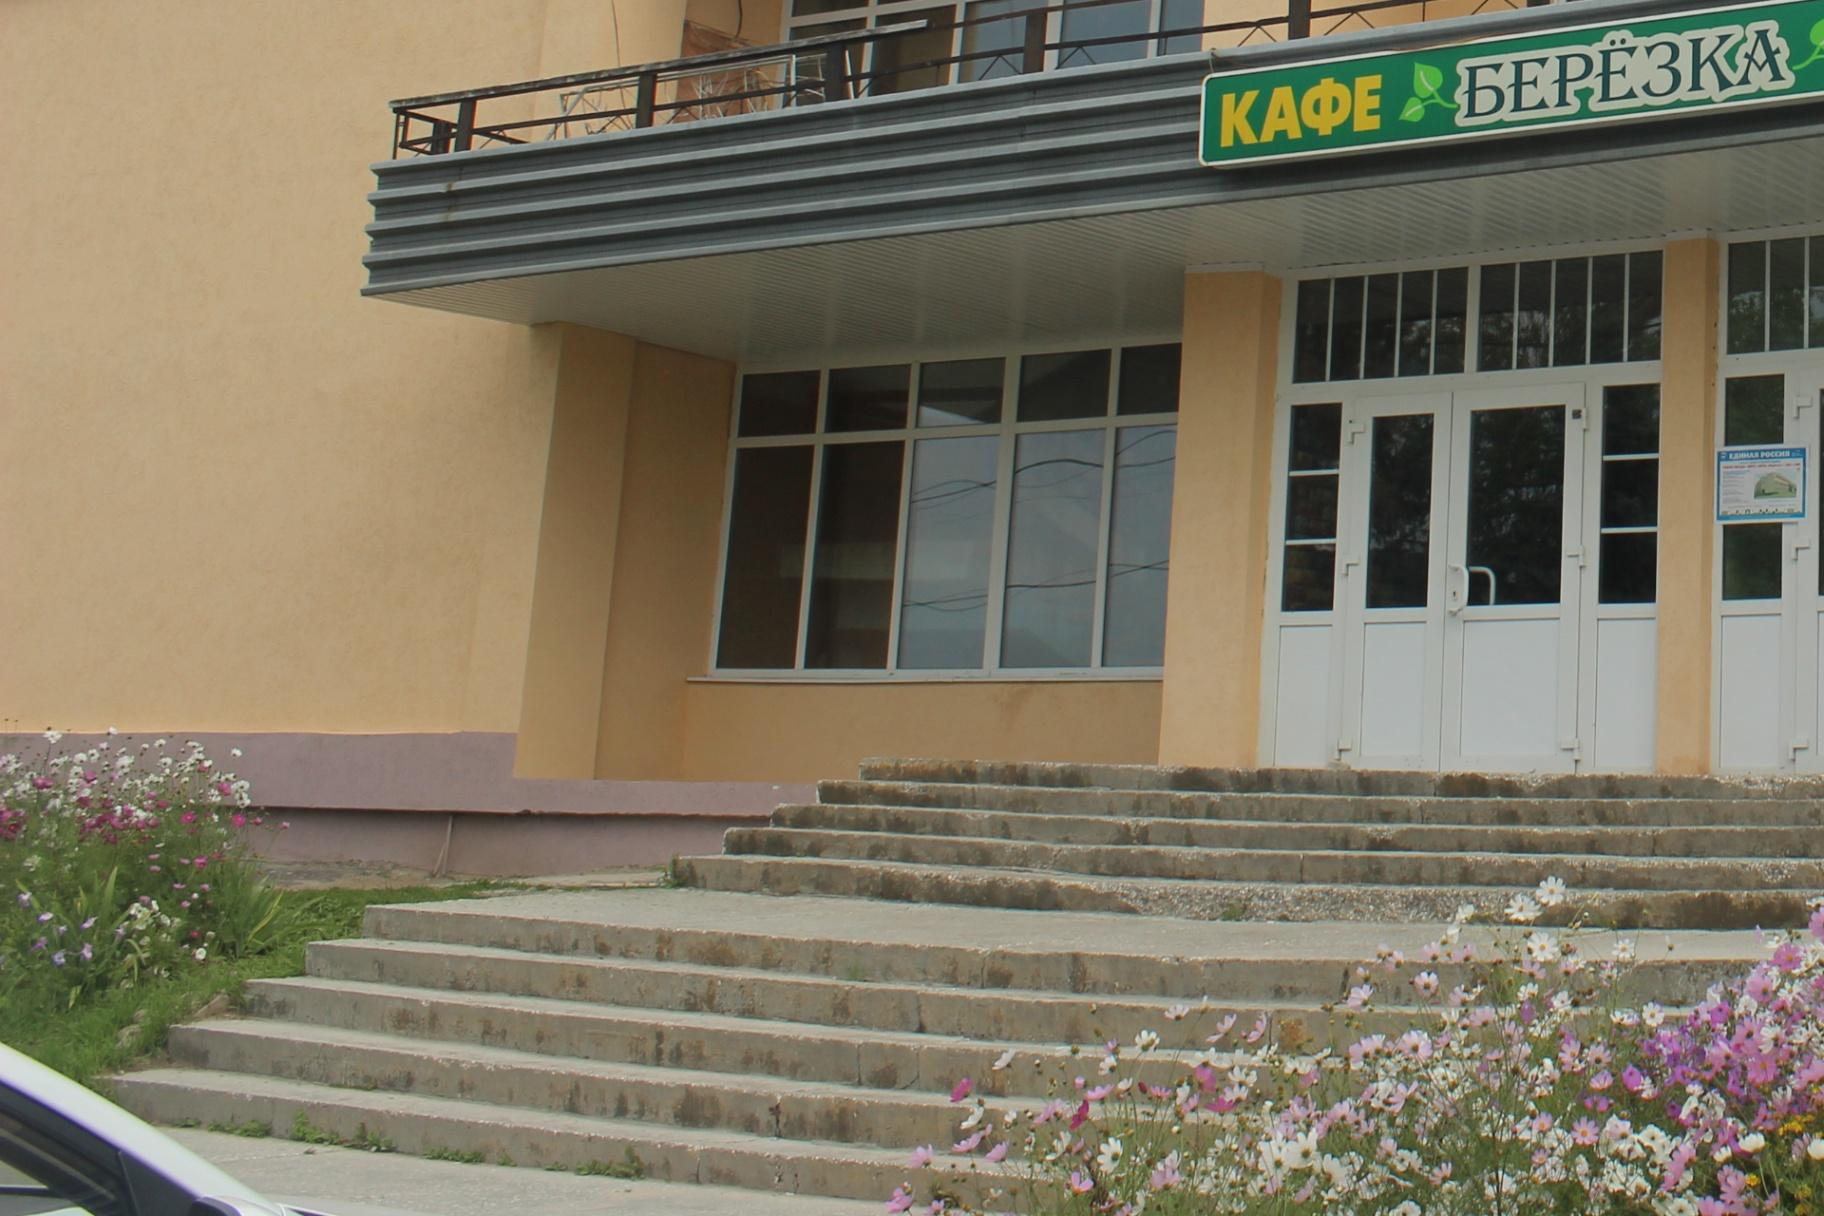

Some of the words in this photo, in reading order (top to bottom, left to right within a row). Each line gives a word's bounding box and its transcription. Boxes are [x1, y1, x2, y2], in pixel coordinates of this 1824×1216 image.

[1220, 74, 1382, 148] КАФЕ
[1463, 27, 1783, 118] БЕРЁЗКА
[1760, 450, 1790, 458] РОССИЯ
